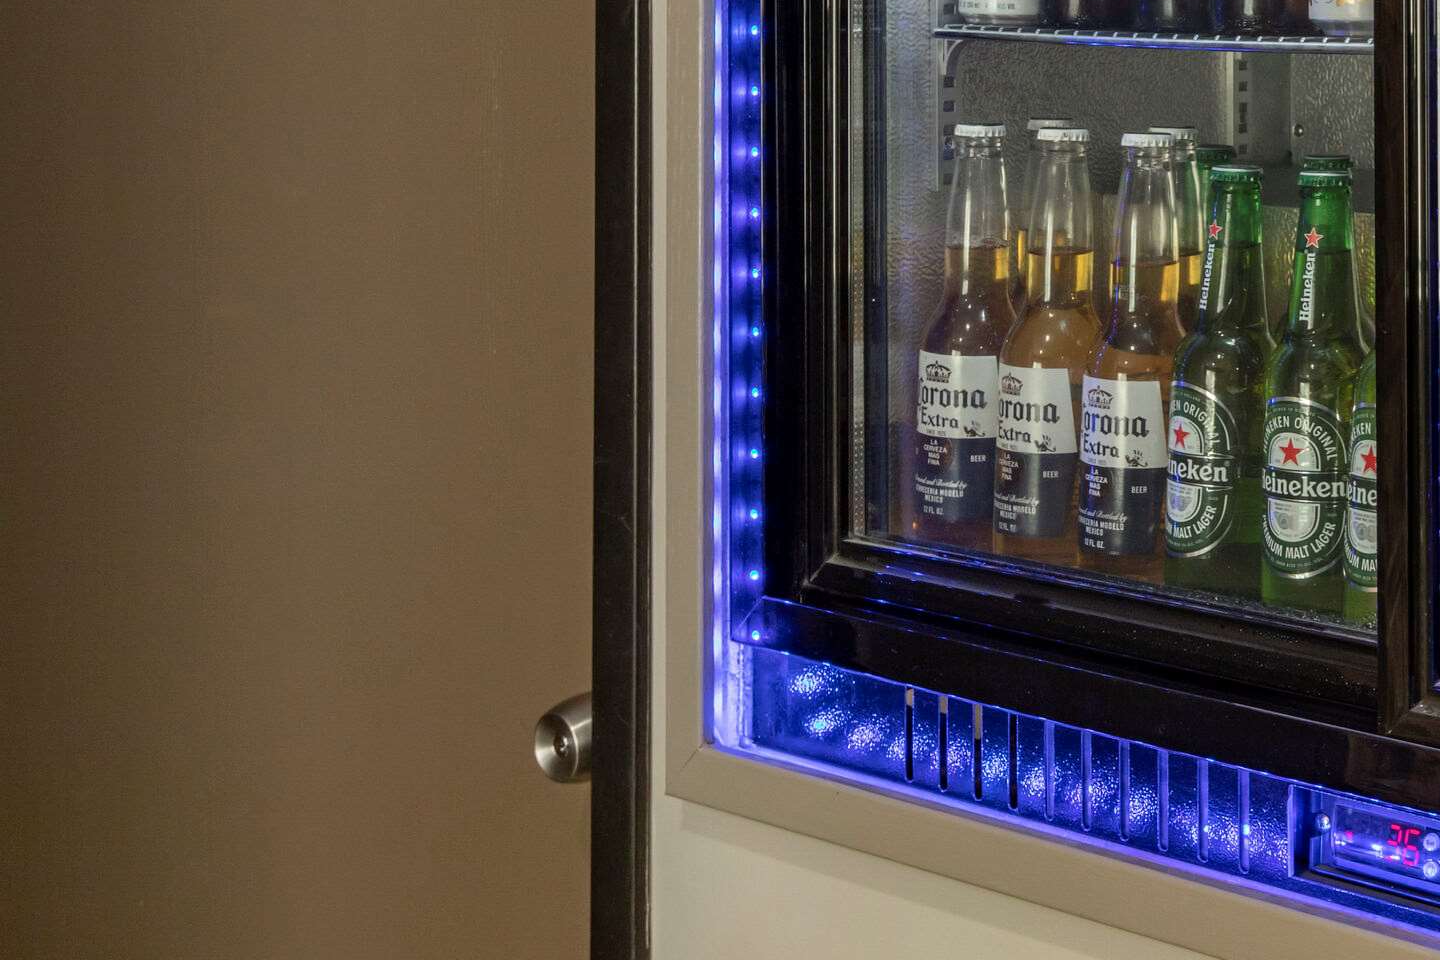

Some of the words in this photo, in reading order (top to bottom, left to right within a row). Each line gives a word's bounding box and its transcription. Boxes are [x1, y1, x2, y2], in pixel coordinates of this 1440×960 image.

[1200, 242, 1216, 310] Heineken
[1299, 251, 1317, 322] Heineken
[920, 406, 959, 429] Extra
[999, 399, 1060, 424] orona
[1082, 410, 1150, 437] orona
[999, 420, 1032, 443] Extra
[1295, 416, 1338, 461] ORIGINAL
[1083, 433, 1120, 459] Extra
[970, 455, 987, 463] BEER
[1042, 470, 1059, 479] BEER
[940, 488, 964, 498] MODELO
[1131, 485, 1148, 494] BEER
[1100, 521, 1125, 531] MODELO
[1173, 526, 1192, 539] MALT
[1193, 505, 1217, 535] LAGER
[1285, 546, 1310, 559] MALT
[1311, 521, 1337, 553] LAGER
